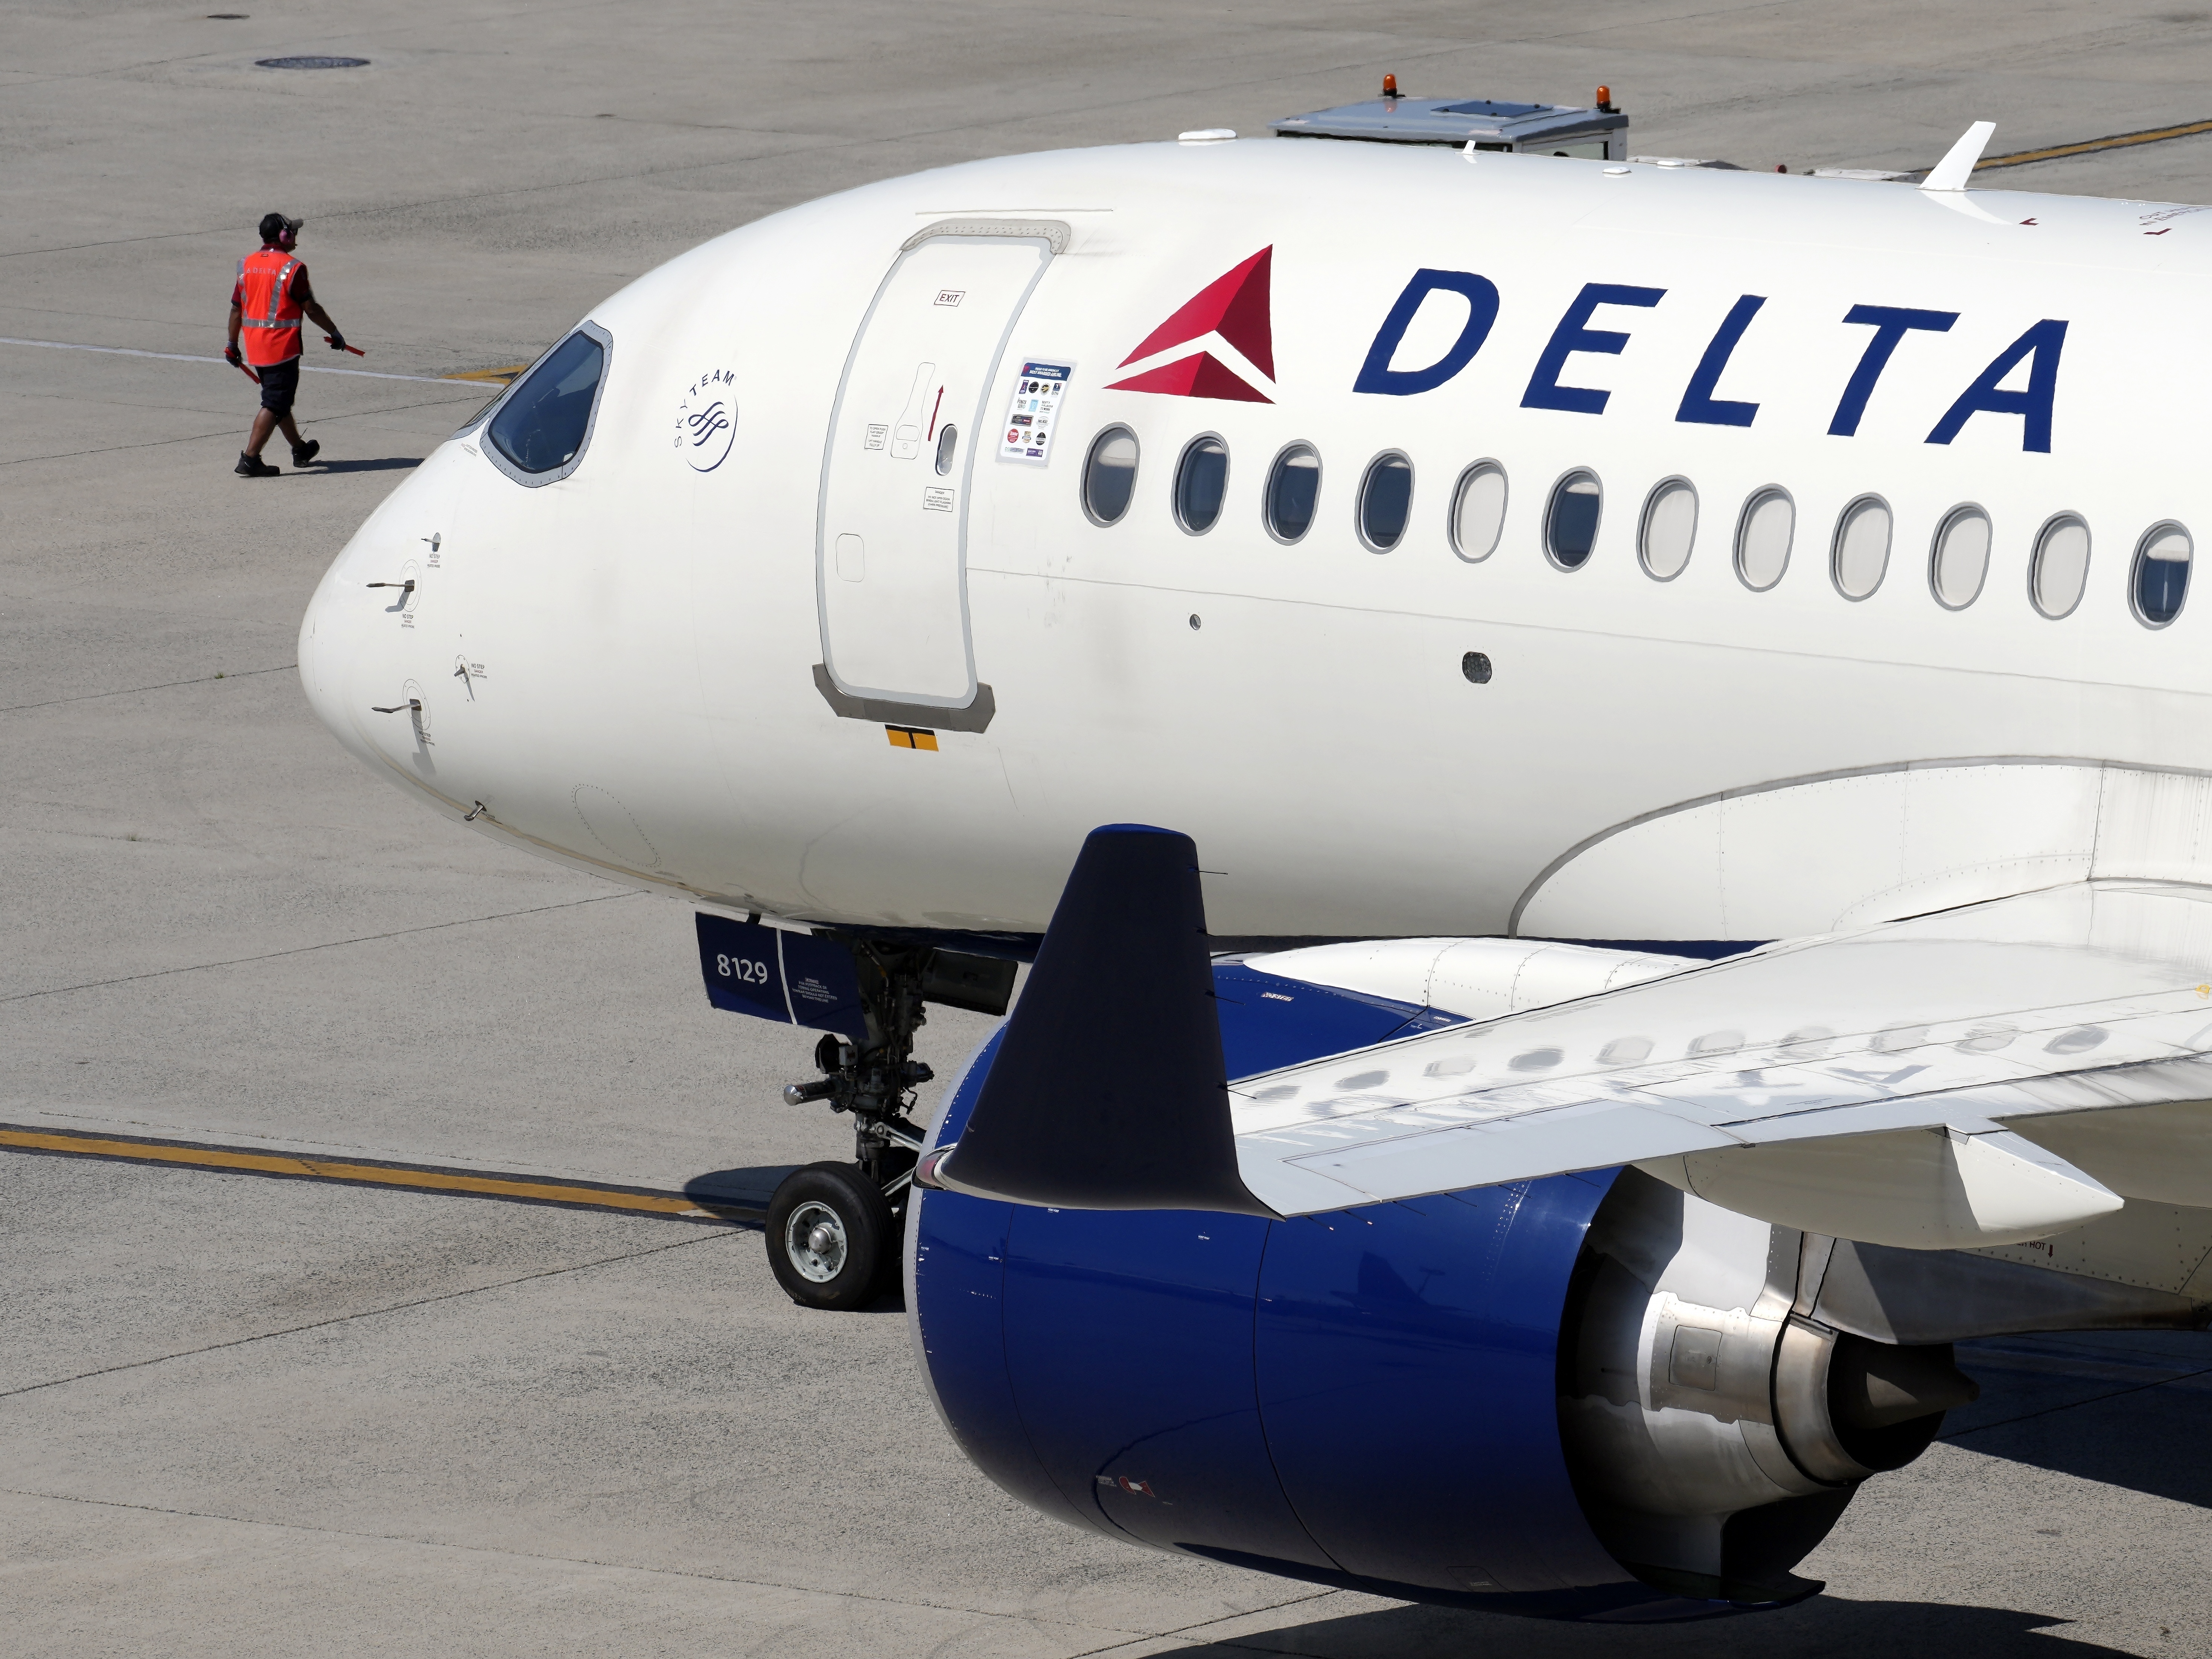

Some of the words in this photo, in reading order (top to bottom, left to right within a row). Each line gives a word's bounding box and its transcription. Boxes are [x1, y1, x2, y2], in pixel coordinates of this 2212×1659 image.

[253, 266, 276, 276] DELTA
[939, 294, 960, 303] EXIT
[1352, 268, 2069, 454] DELTA
[674, 369, 734, 448] SKYTEAM
[717, 954, 767, 985] 8129
[2029, 1241, 2046, 1250] HOT
